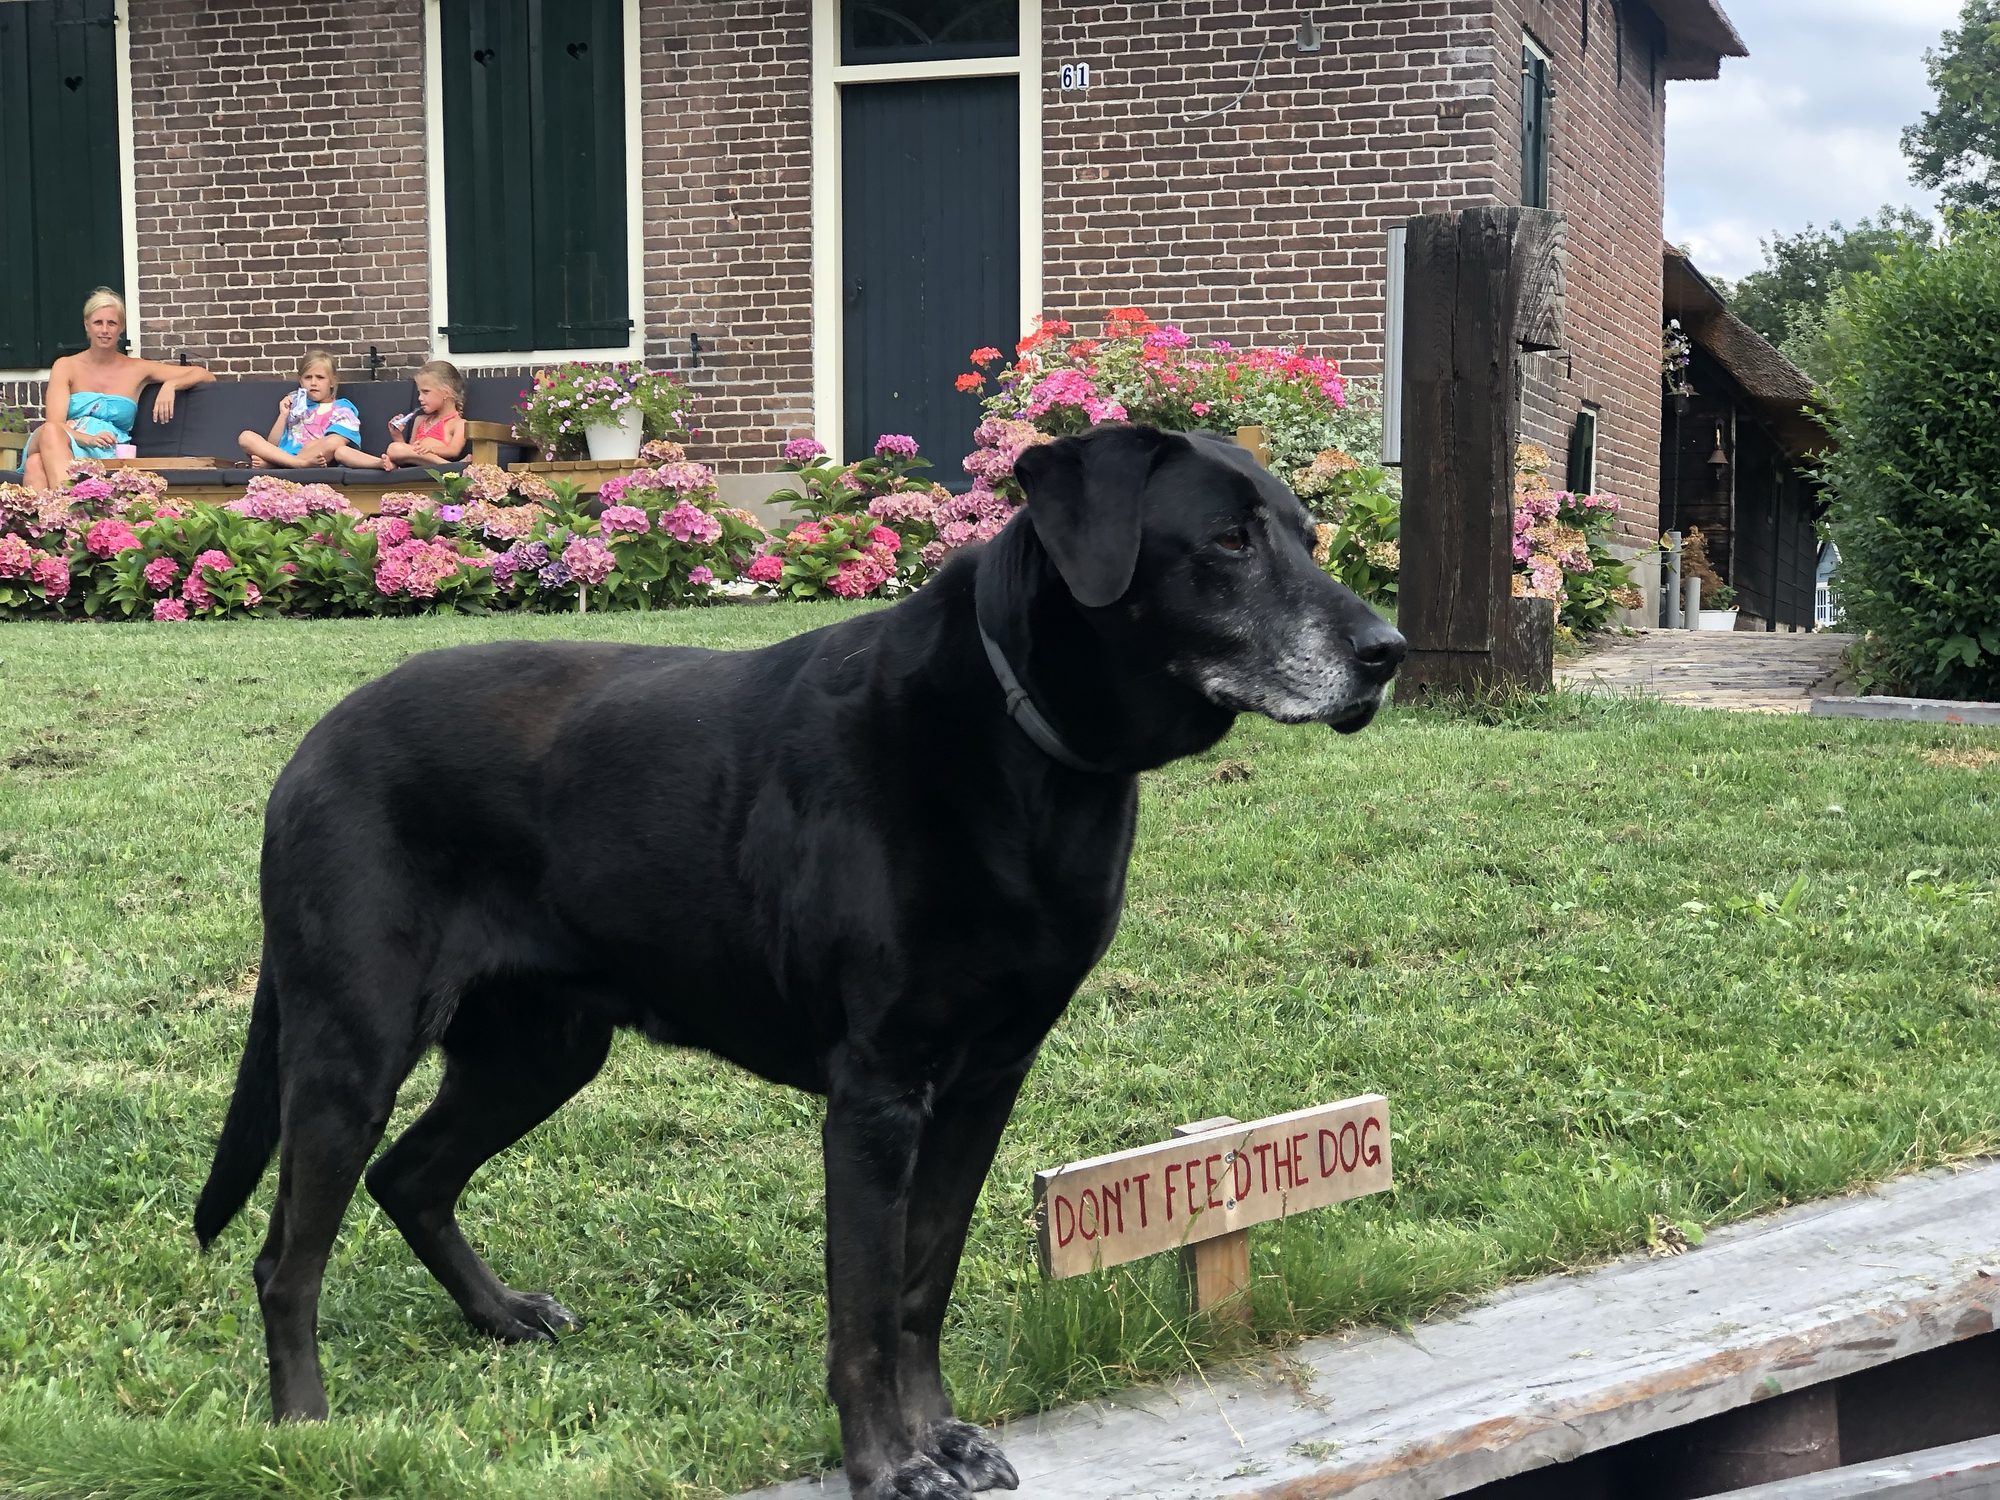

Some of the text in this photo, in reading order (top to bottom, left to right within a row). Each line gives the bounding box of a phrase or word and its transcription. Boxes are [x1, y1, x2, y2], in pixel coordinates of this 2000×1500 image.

[1063, 66, 1087, 88] 61
[1054, 1116, 1382, 1248] DON'T FEED THE DOG
